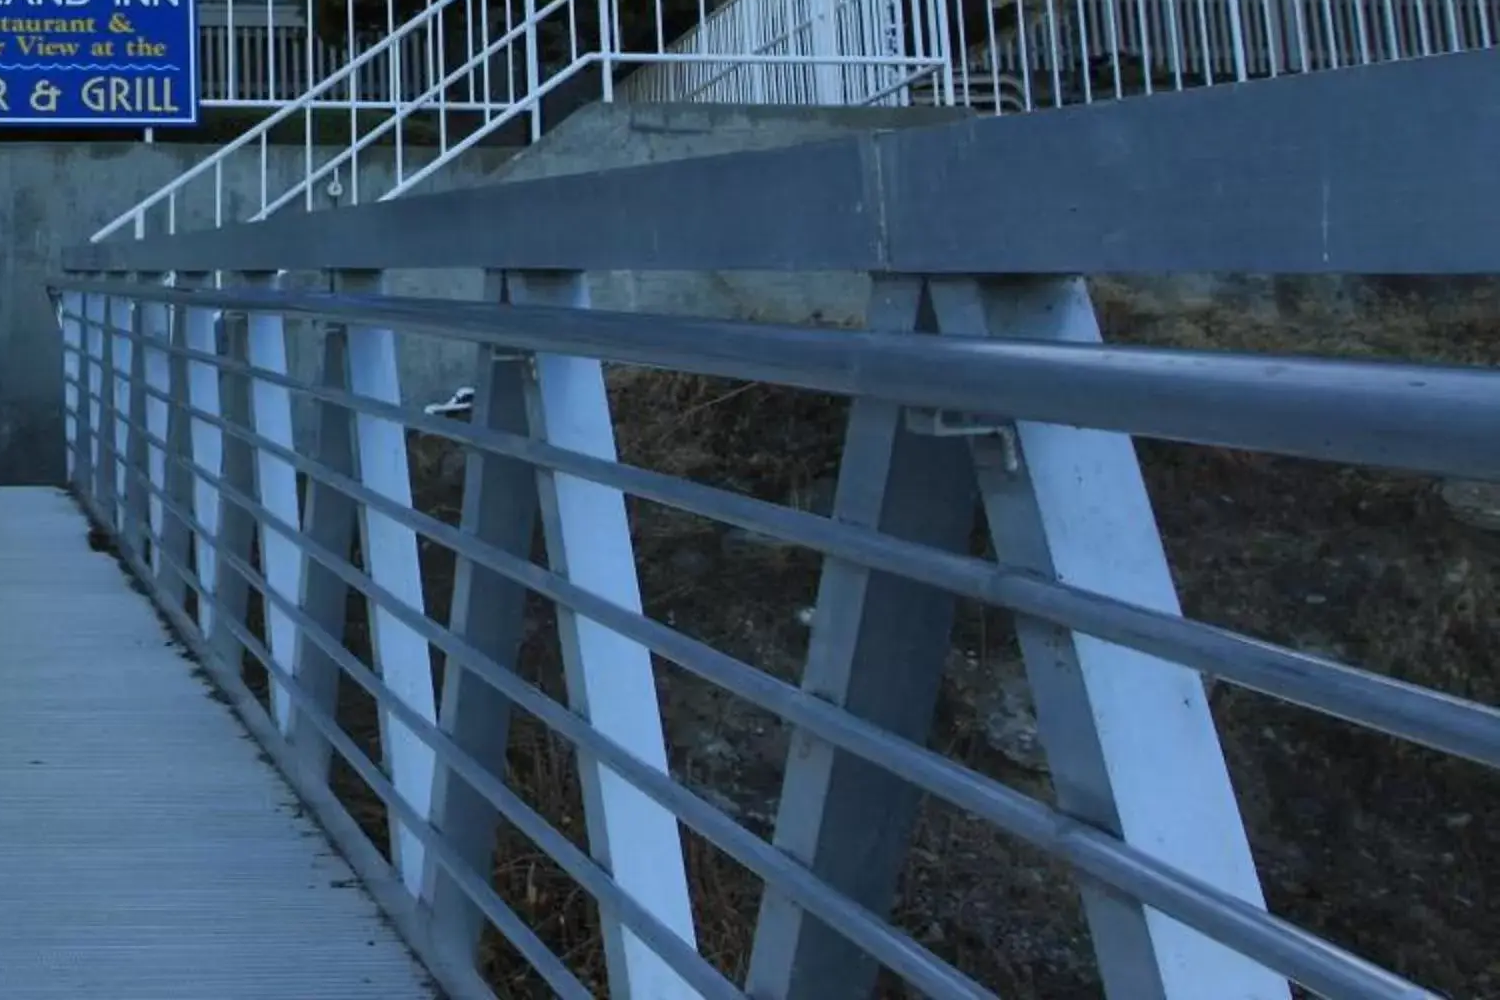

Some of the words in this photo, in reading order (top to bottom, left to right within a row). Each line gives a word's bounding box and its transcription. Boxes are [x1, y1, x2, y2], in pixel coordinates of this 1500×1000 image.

[108, 13, 134, 33] &
[16, 35, 80, 56] View
[90, 41, 114, 57] at
[126, 36, 167, 57] the
[29, 79, 62, 112] &
[81, 76, 179, 112] GRILL
